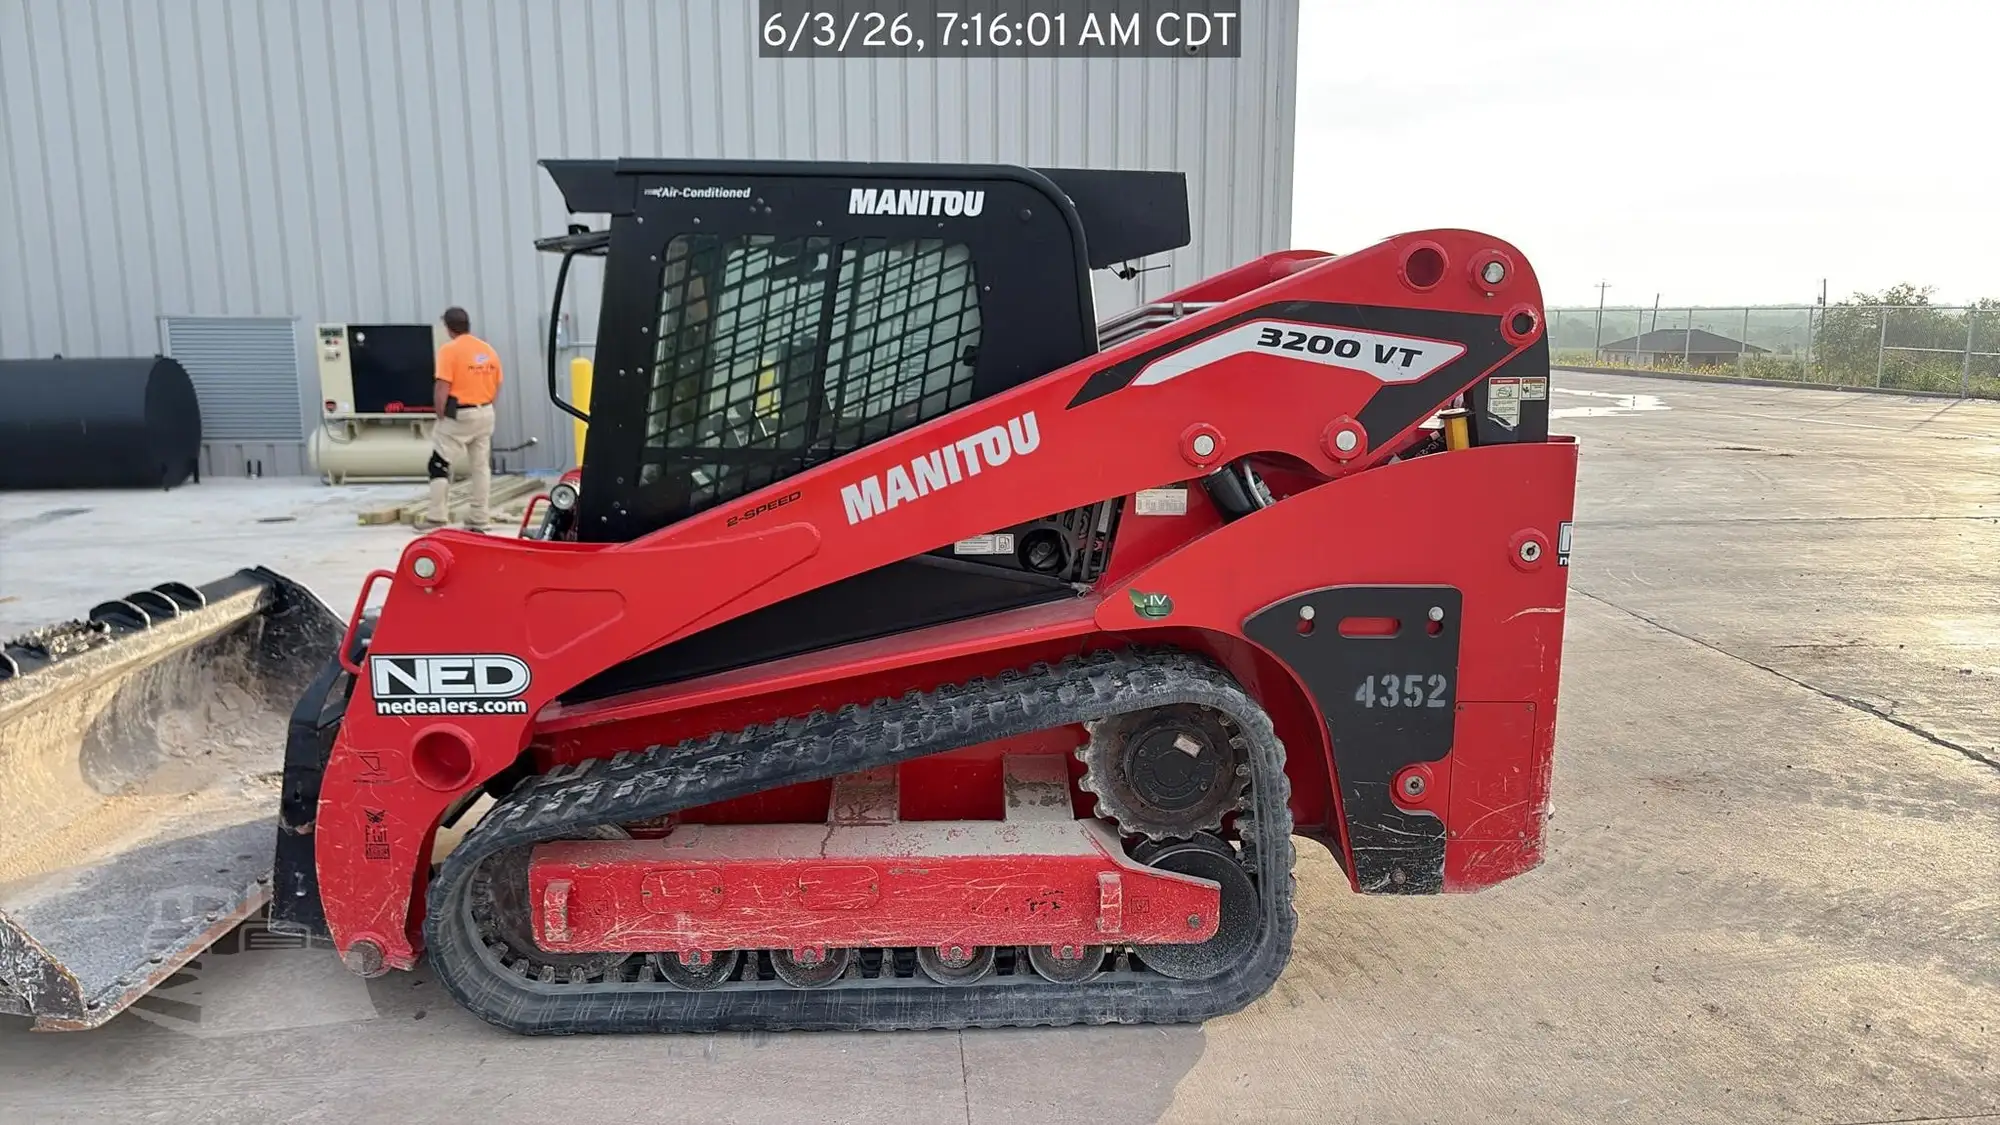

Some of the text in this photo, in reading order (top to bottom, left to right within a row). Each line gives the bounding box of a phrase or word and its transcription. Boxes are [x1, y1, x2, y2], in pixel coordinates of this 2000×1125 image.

[661, 187, 751, 199] Air-Conditioned
[848, 188, 985, 217] MANITOU
[1257, 327, 1424, 368] 3200 VT
[840, 411, 1041, 525] MANITOU
[726, 491, 801, 527] 2-SPEED
[373, 657, 529, 695] NED
[1355, 674, 1447, 708] 4352
[377, 698, 527, 714] nedealers.com
